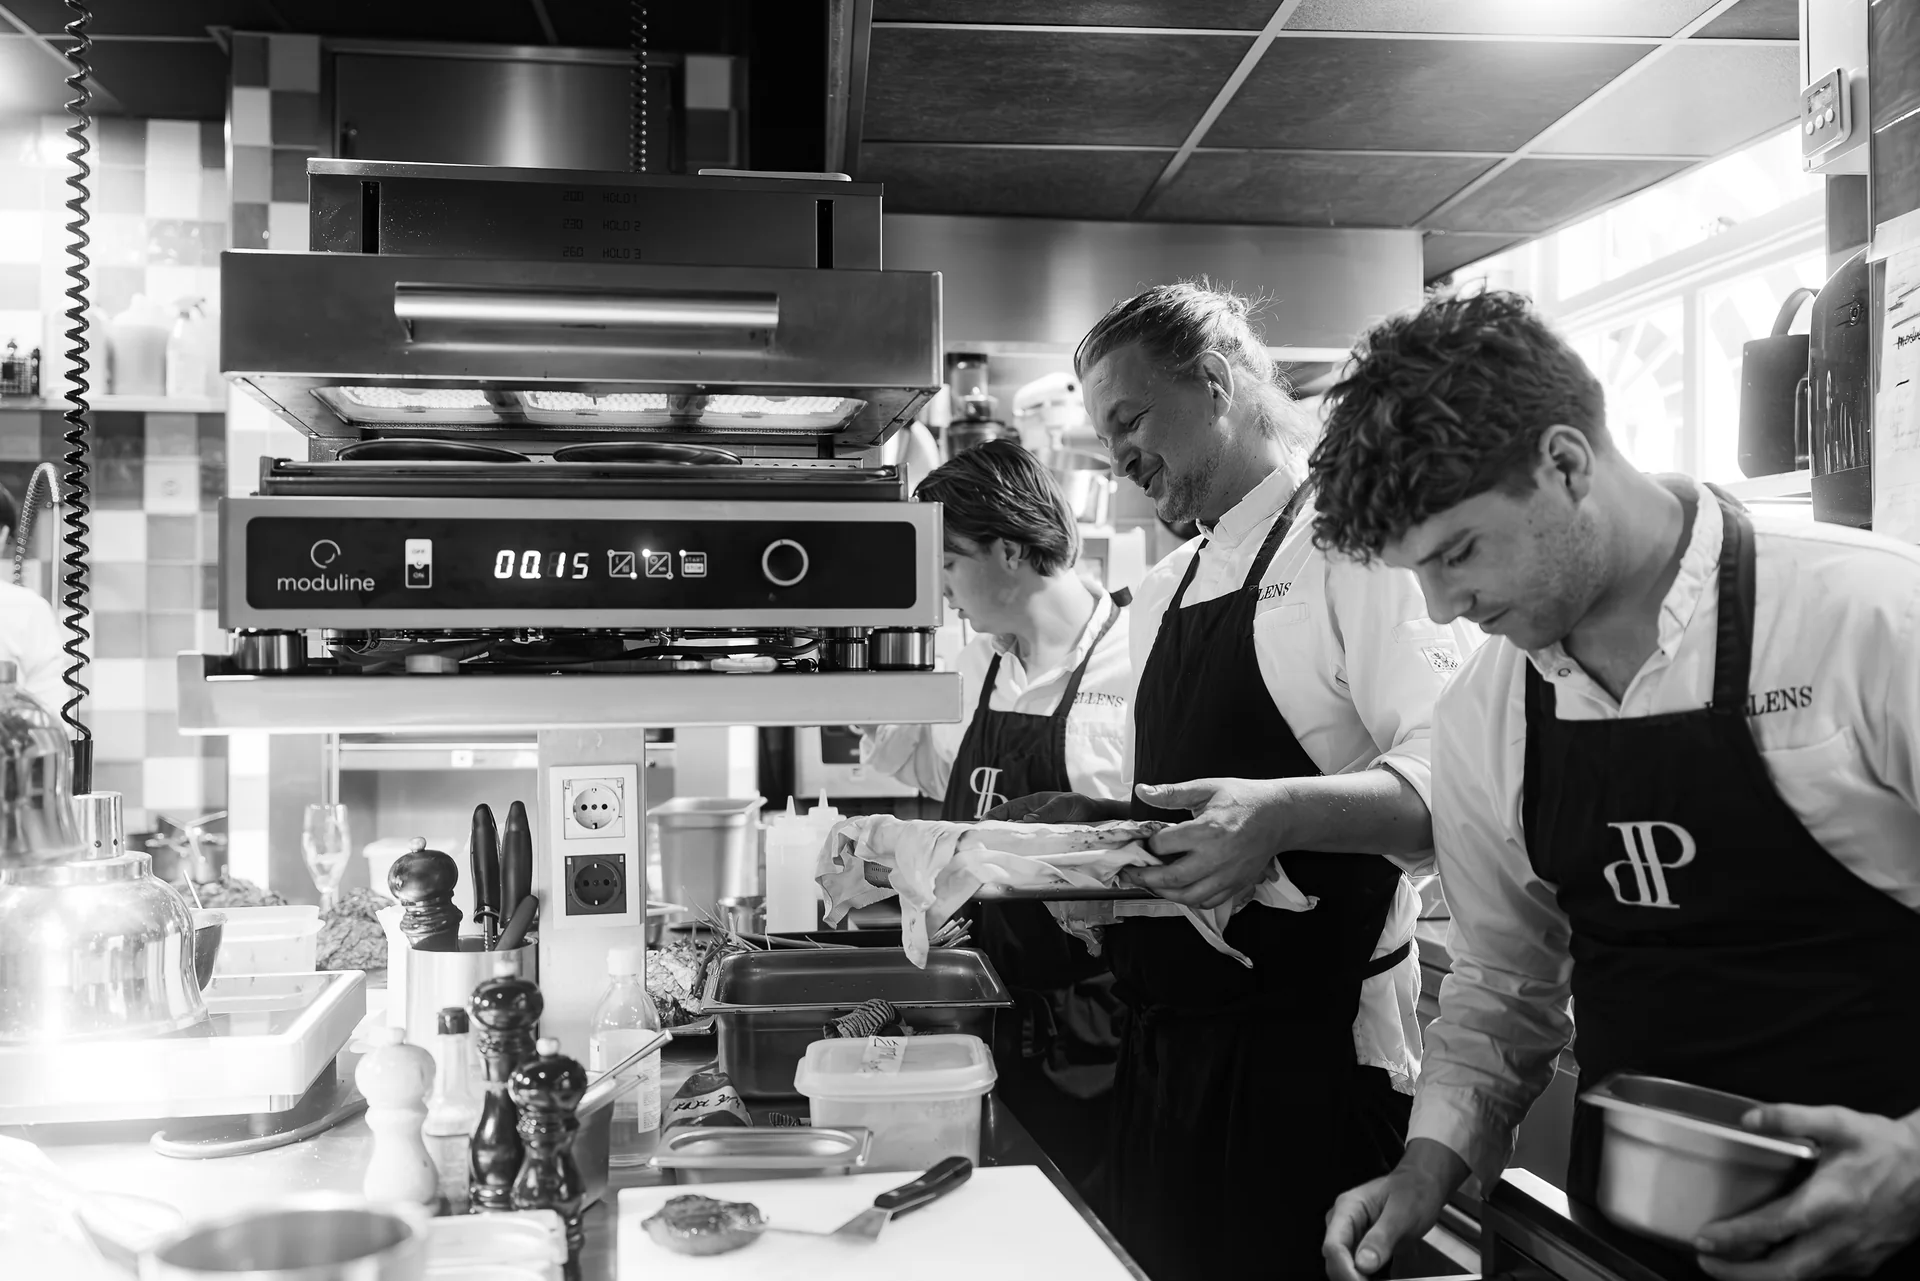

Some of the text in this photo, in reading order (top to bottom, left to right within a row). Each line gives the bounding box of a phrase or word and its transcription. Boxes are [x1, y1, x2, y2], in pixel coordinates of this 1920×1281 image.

[562, 190, 584, 202] 200
[602, 192, 631, 204] HOLD
[562, 218, 641, 232] 230 HOLD 2
[562, 246, 641, 259] 260 HOLD 3
[277, 573, 376, 592] moduline
[1744, 685, 1813, 717] LENS
